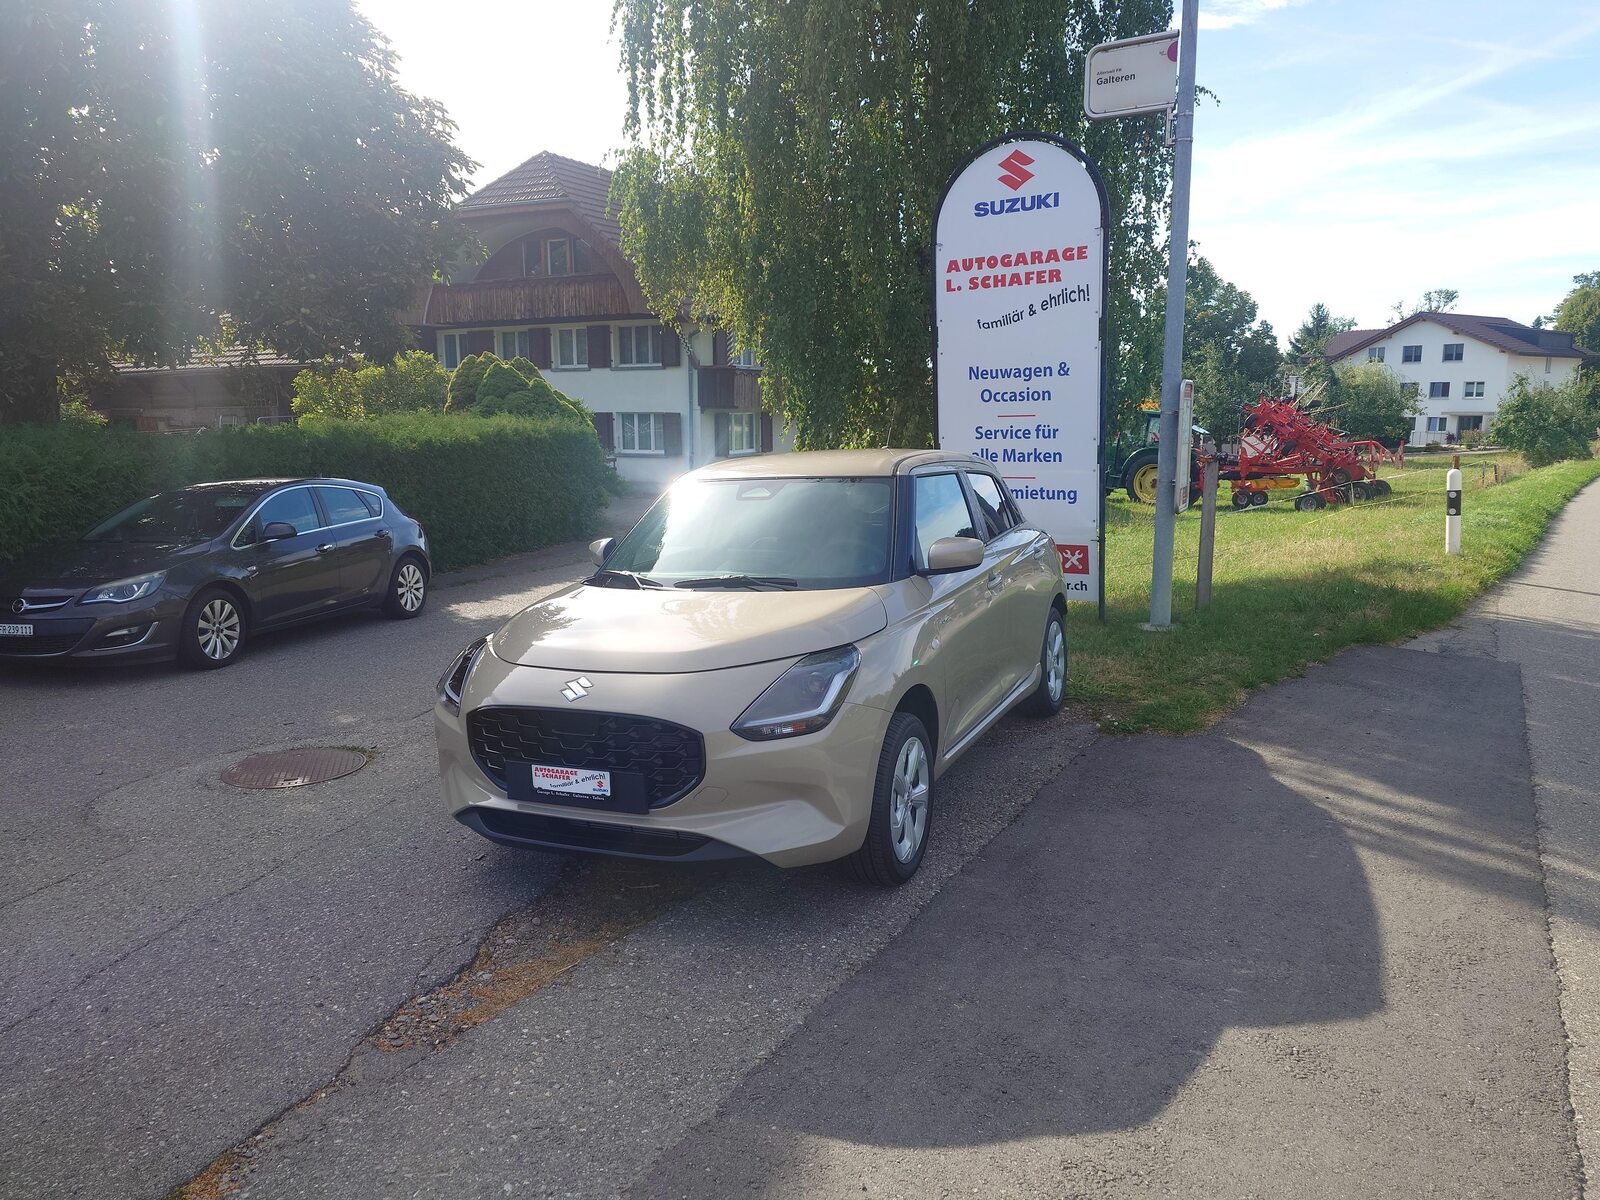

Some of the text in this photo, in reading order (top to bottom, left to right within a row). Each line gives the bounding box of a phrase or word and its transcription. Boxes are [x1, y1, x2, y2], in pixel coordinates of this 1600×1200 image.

[1097, 74, 1135, 85] Galteren
[974, 191, 1060, 218] SUZUKI
[946, 245, 1088, 274] AUTOGARAGE
[946, 268, 1062, 293] L. SCHAFER
[977, 283, 1090, 330] familiär & ehrlich!
[968, 361, 1070, 382] Neuwagen &
[980, 386, 1052, 403] Occasion
[975, 424, 1059, 440] Service für
[1002, 448, 1063, 463] Marken
[1010, 485, 1078, 504] mietung
[534, 767, 578, 776] AUTOGARAGE
